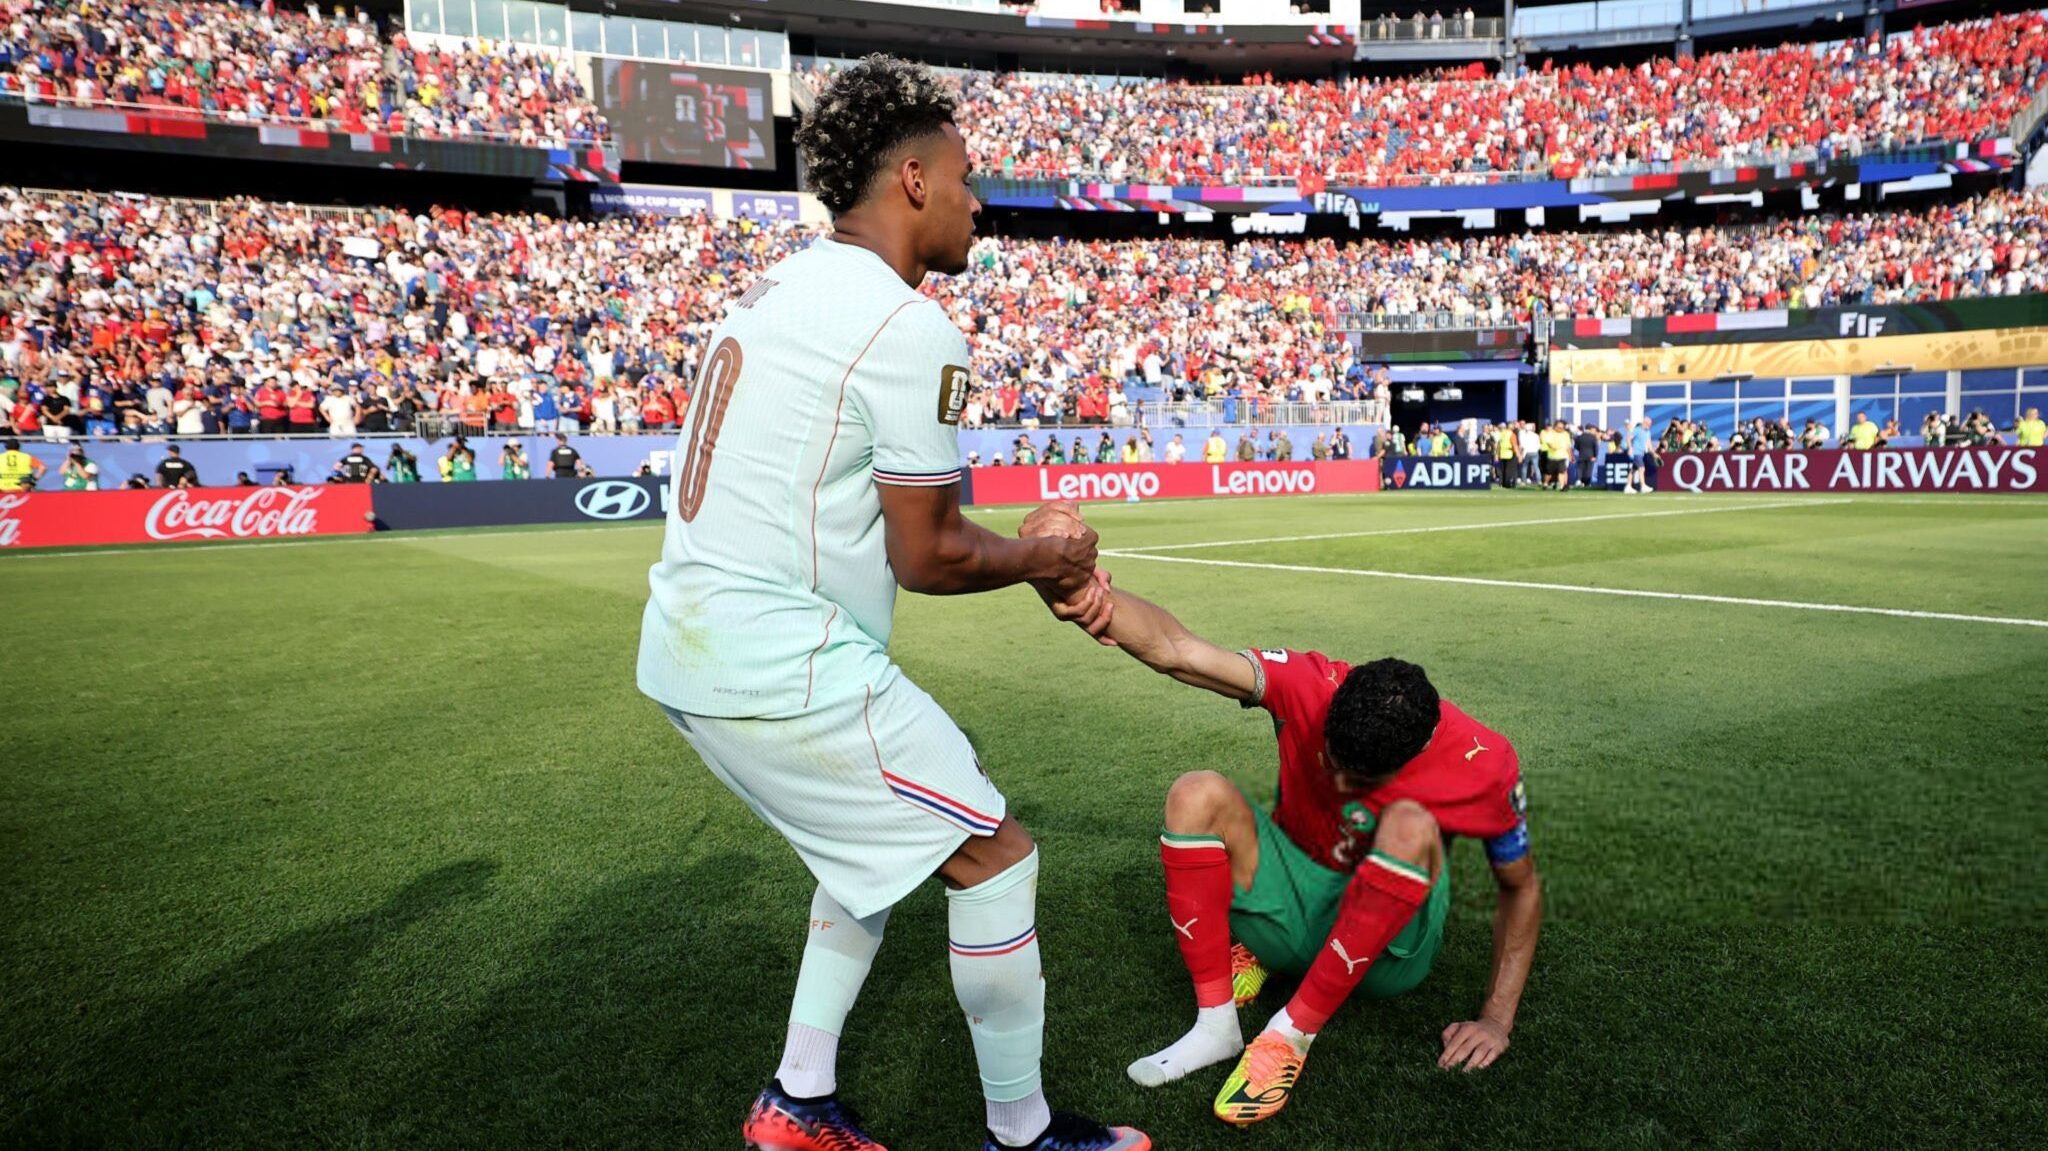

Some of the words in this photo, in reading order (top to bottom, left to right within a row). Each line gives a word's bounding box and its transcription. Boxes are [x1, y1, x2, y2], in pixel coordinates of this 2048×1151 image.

[1314, 192, 1359, 216] FIFA
[1840, 312, 1887, 337] FIF
[676, 331, 743, 523] 0
[1040, 468, 1160, 499] Lenovo
[1212, 465, 1316, 494] Lenovo
[1409, 462, 1461, 486] ADI
[1672, 453, 1810, 493] QATAR
[1828, 449, 2038, 490] AIRWAYS
[145, 487, 325, 541] Coca-Cola
